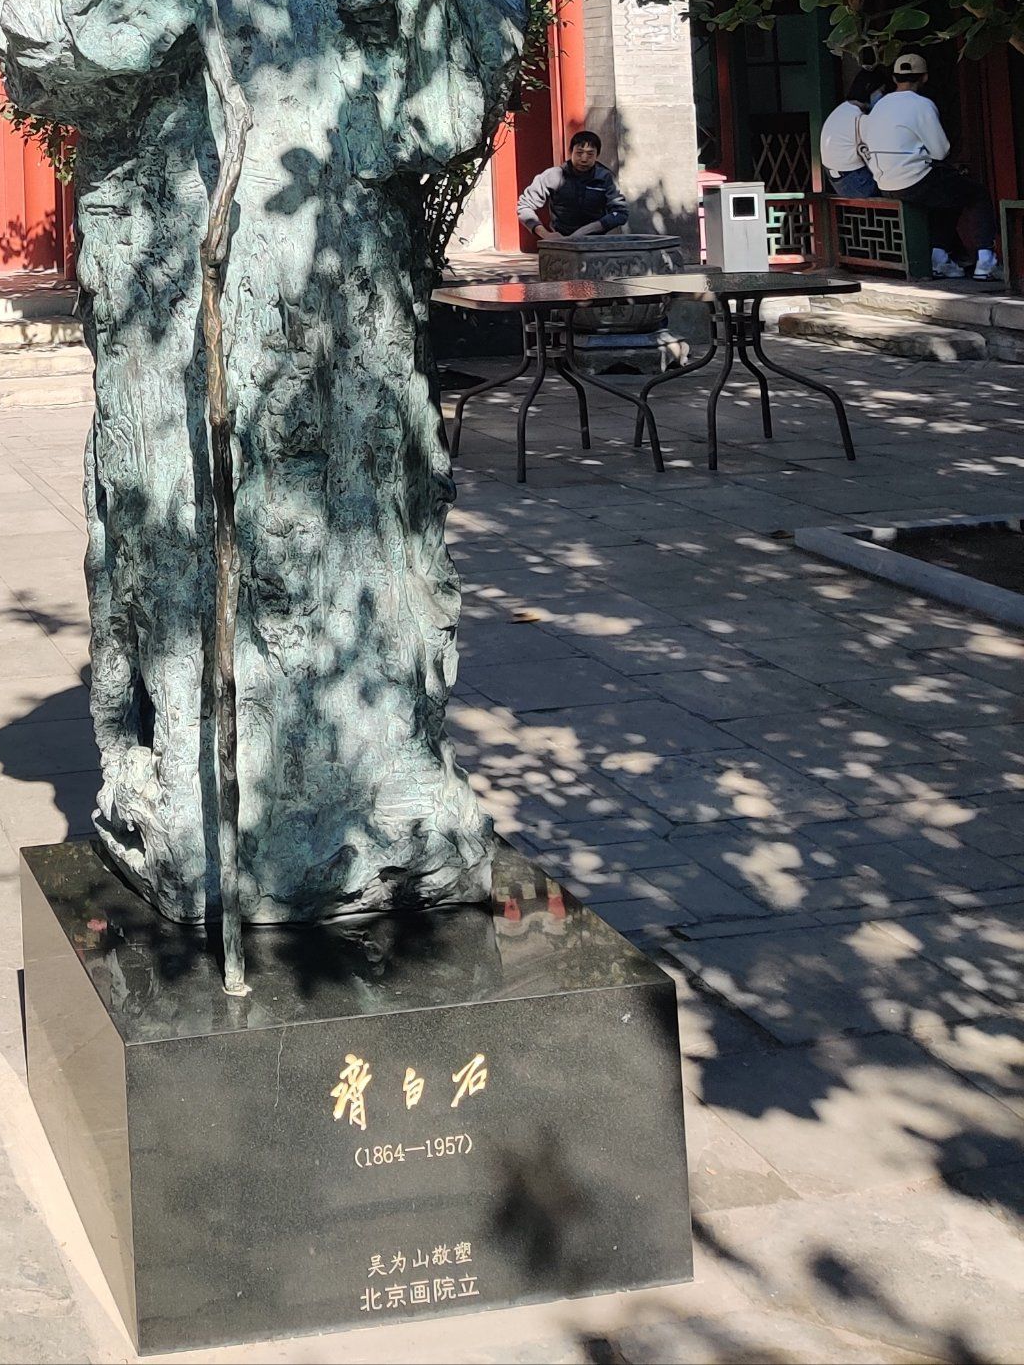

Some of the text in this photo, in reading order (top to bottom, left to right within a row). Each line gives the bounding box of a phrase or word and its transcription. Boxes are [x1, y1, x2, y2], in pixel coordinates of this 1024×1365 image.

[367, 1241, 473, 1279] 吴为山敬塑
[360, 1273, 481, 1312] 北京画院立
